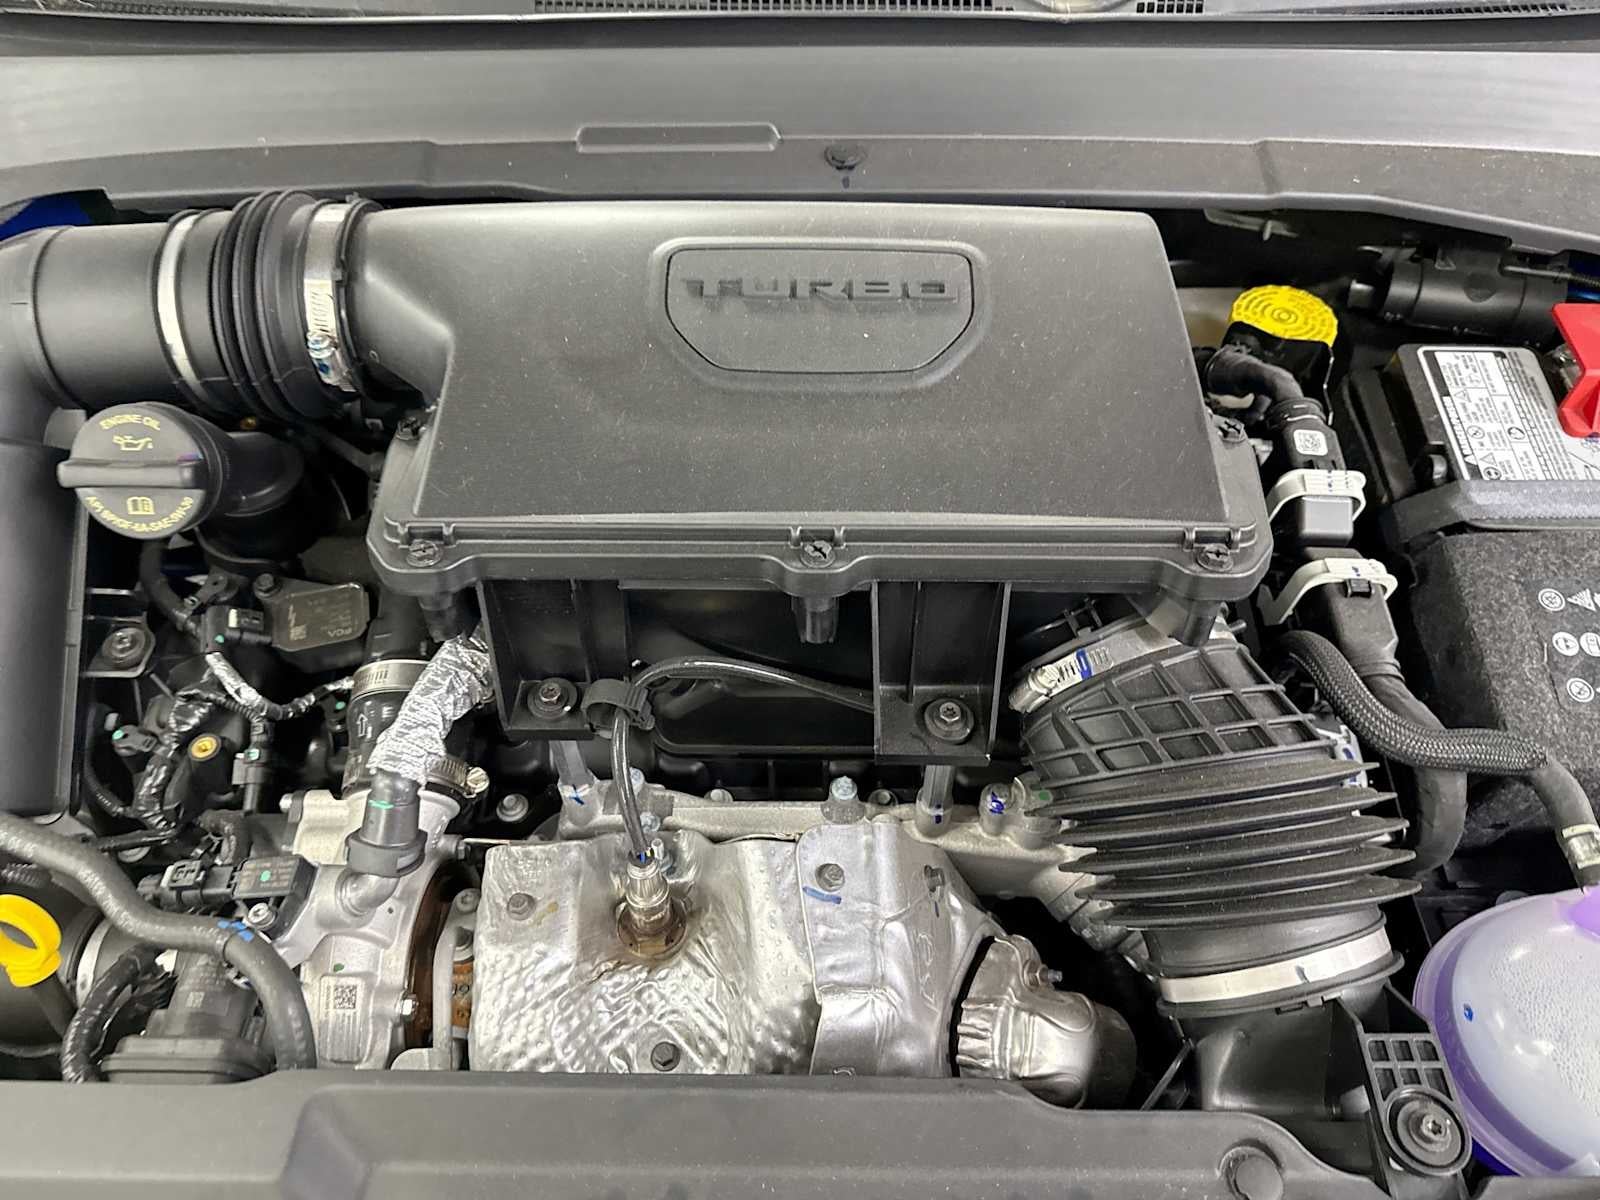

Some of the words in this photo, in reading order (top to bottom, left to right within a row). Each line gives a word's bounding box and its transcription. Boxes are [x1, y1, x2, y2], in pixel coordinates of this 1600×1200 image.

[681, 273, 958, 302] TURBO
[100, 414, 142, 430] ENGINE
[142, 416, 161, 431] OIL
